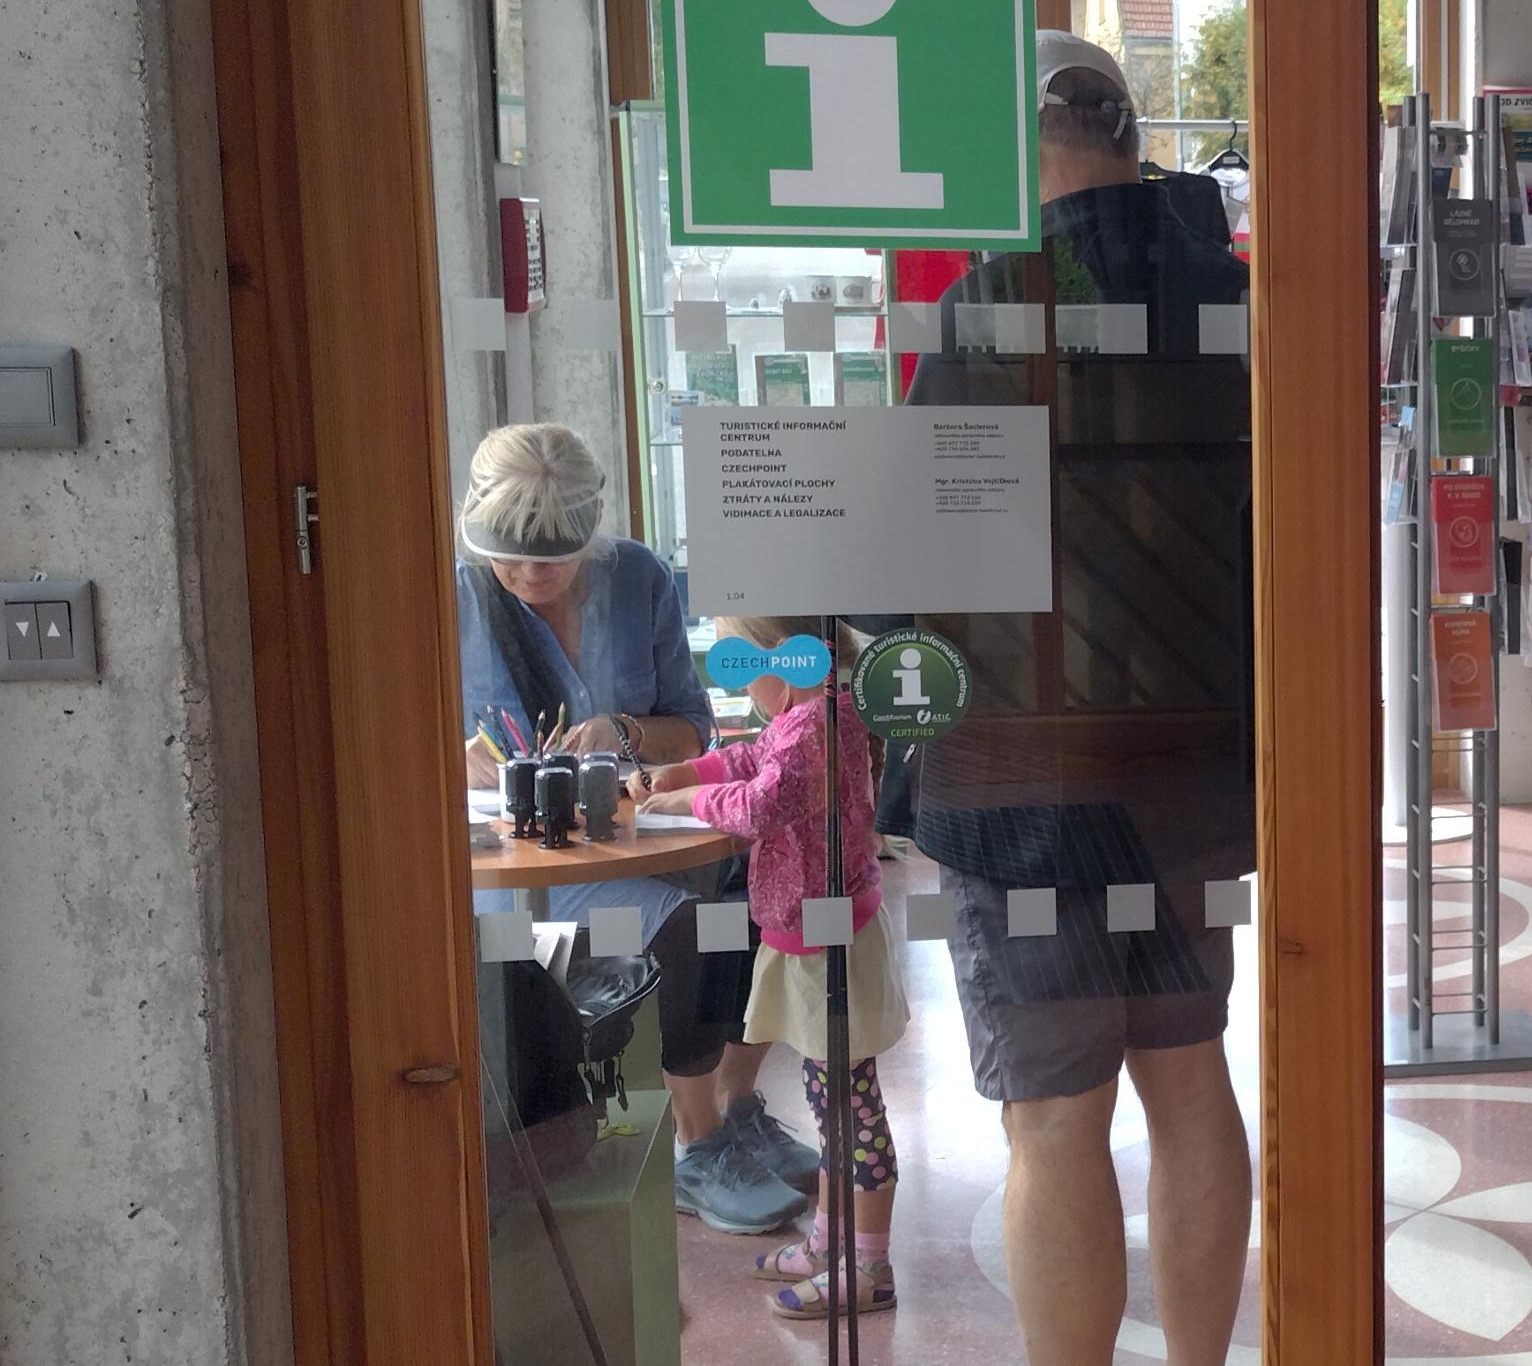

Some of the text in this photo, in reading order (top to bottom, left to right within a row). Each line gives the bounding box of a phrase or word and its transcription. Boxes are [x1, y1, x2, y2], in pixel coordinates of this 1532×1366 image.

[720, 420, 847, 430] TURISTICKÉ INFORMAČNÍ
[720, 434, 770, 442] CENTRUM
[721, 449, 782, 457] PODATELNA
[721, 464, 787, 473] CZECHPOINT
[722, 478, 836, 488] PLAKÁTOVACÍ PLOCHY
[722, 493, 813, 504] ZTRÁTY A NÁLEZY
[723, 509, 773, 518] VIDIMACE
[783, 508, 846, 517] LEGALIZACE
[726, 592, 745, 600] 1.04
[854, 631, 968, 711] Certifikované turistické informační centrum
[891, 727, 935, 737] CERTIFIED
